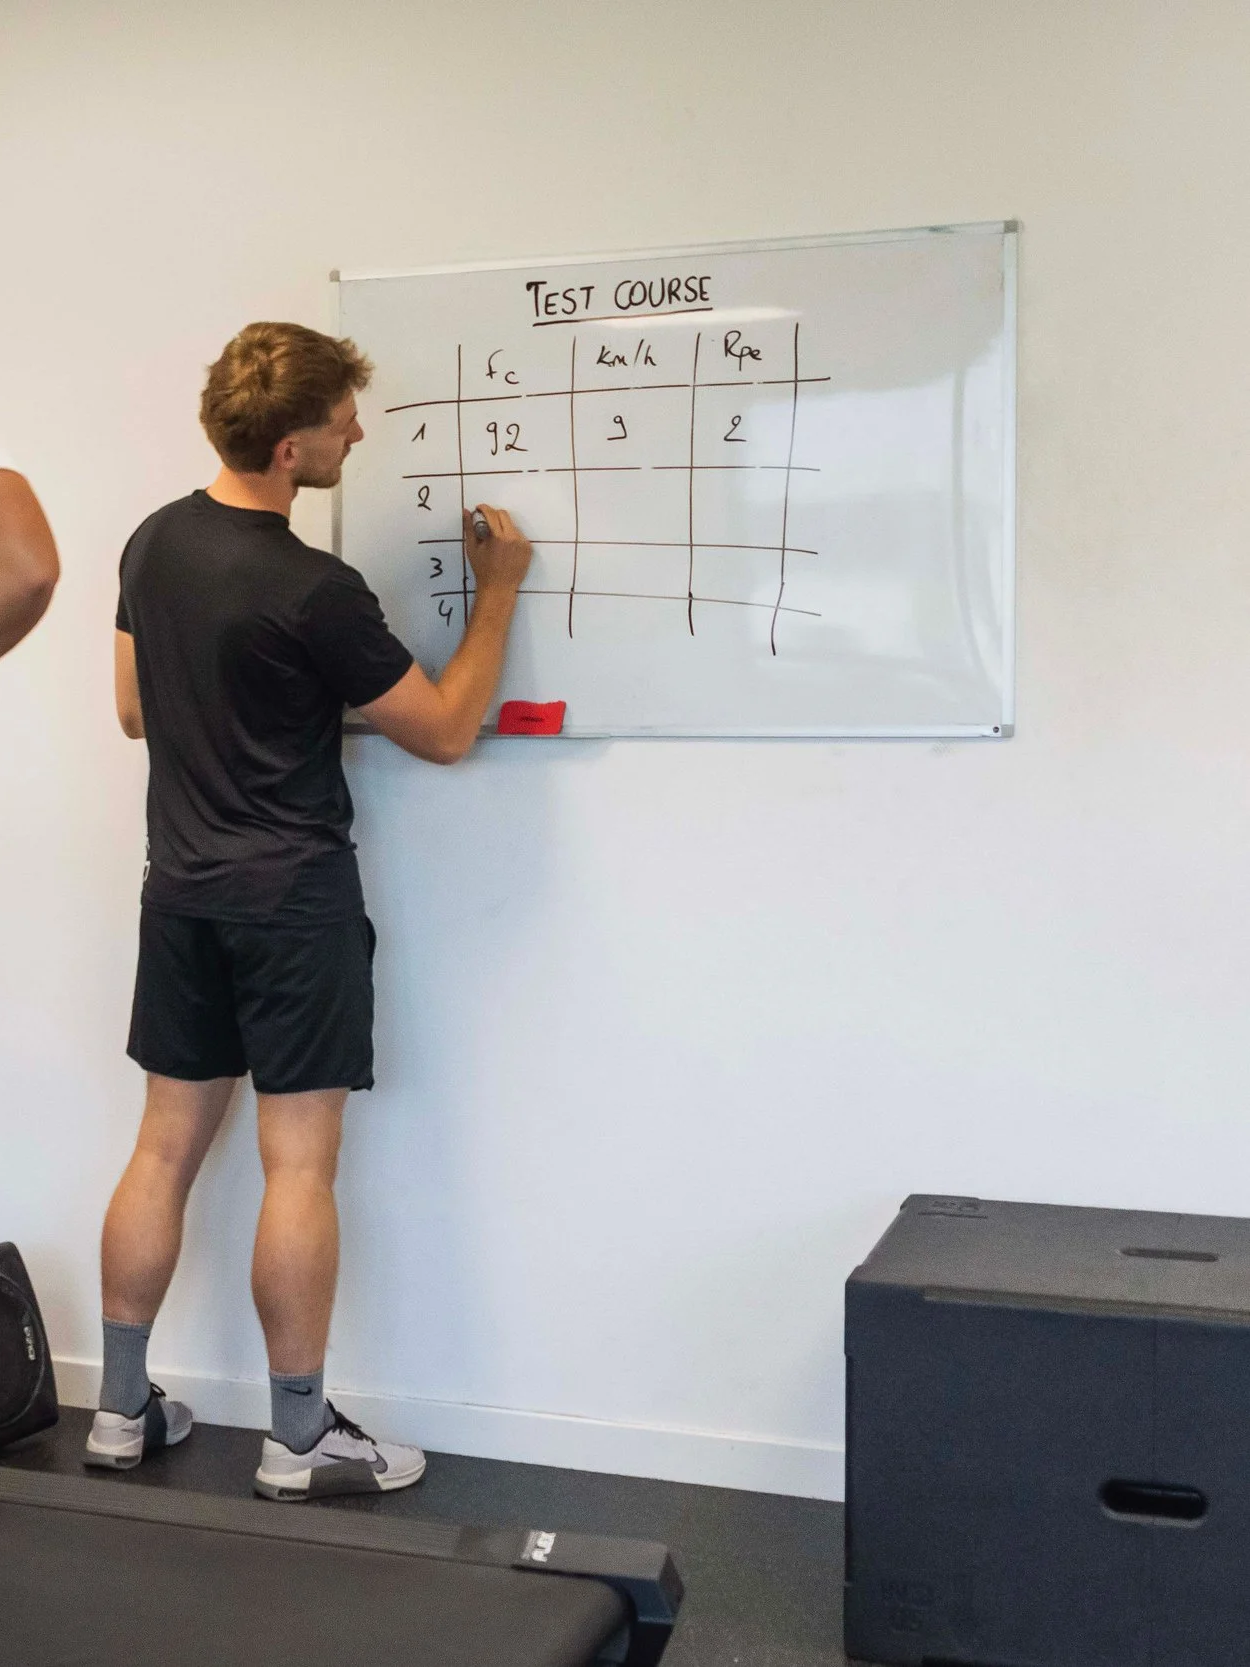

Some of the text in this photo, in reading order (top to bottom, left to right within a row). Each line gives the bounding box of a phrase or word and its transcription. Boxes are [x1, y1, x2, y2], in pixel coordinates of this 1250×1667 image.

[526, 275, 712, 317] TEST COURSE
[411, 414, 747, 456] 1 92 9 2
[417, 484, 432, 512] 2
[429, 557, 444, 579] 3
[438, 599, 454, 627] 4
